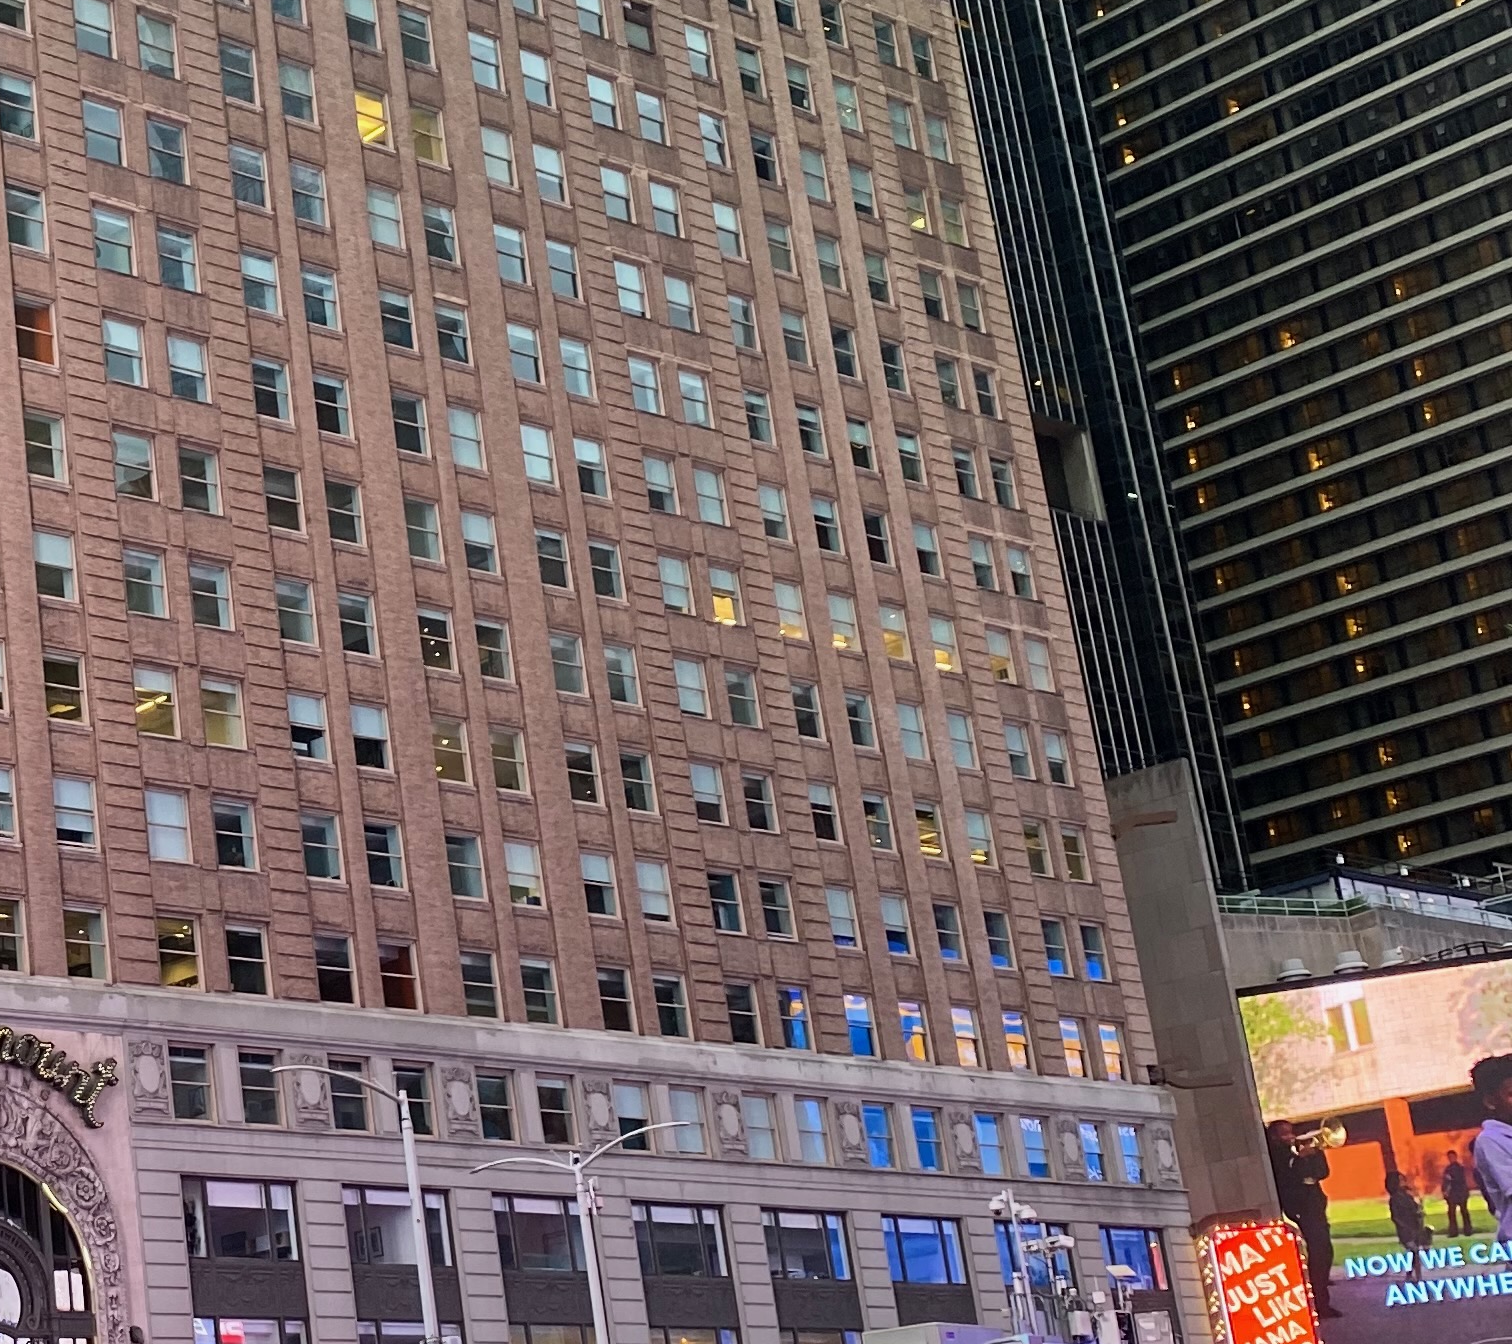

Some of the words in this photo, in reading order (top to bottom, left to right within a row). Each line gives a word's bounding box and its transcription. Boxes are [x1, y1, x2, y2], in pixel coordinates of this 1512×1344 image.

[1345, 1251, 1414, 1278] NOW
[1419, 1246, 1465, 1270] WE
[1469, 1240, 1512, 1264] CA
[1226, 1263, 1290, 1313] JUST
